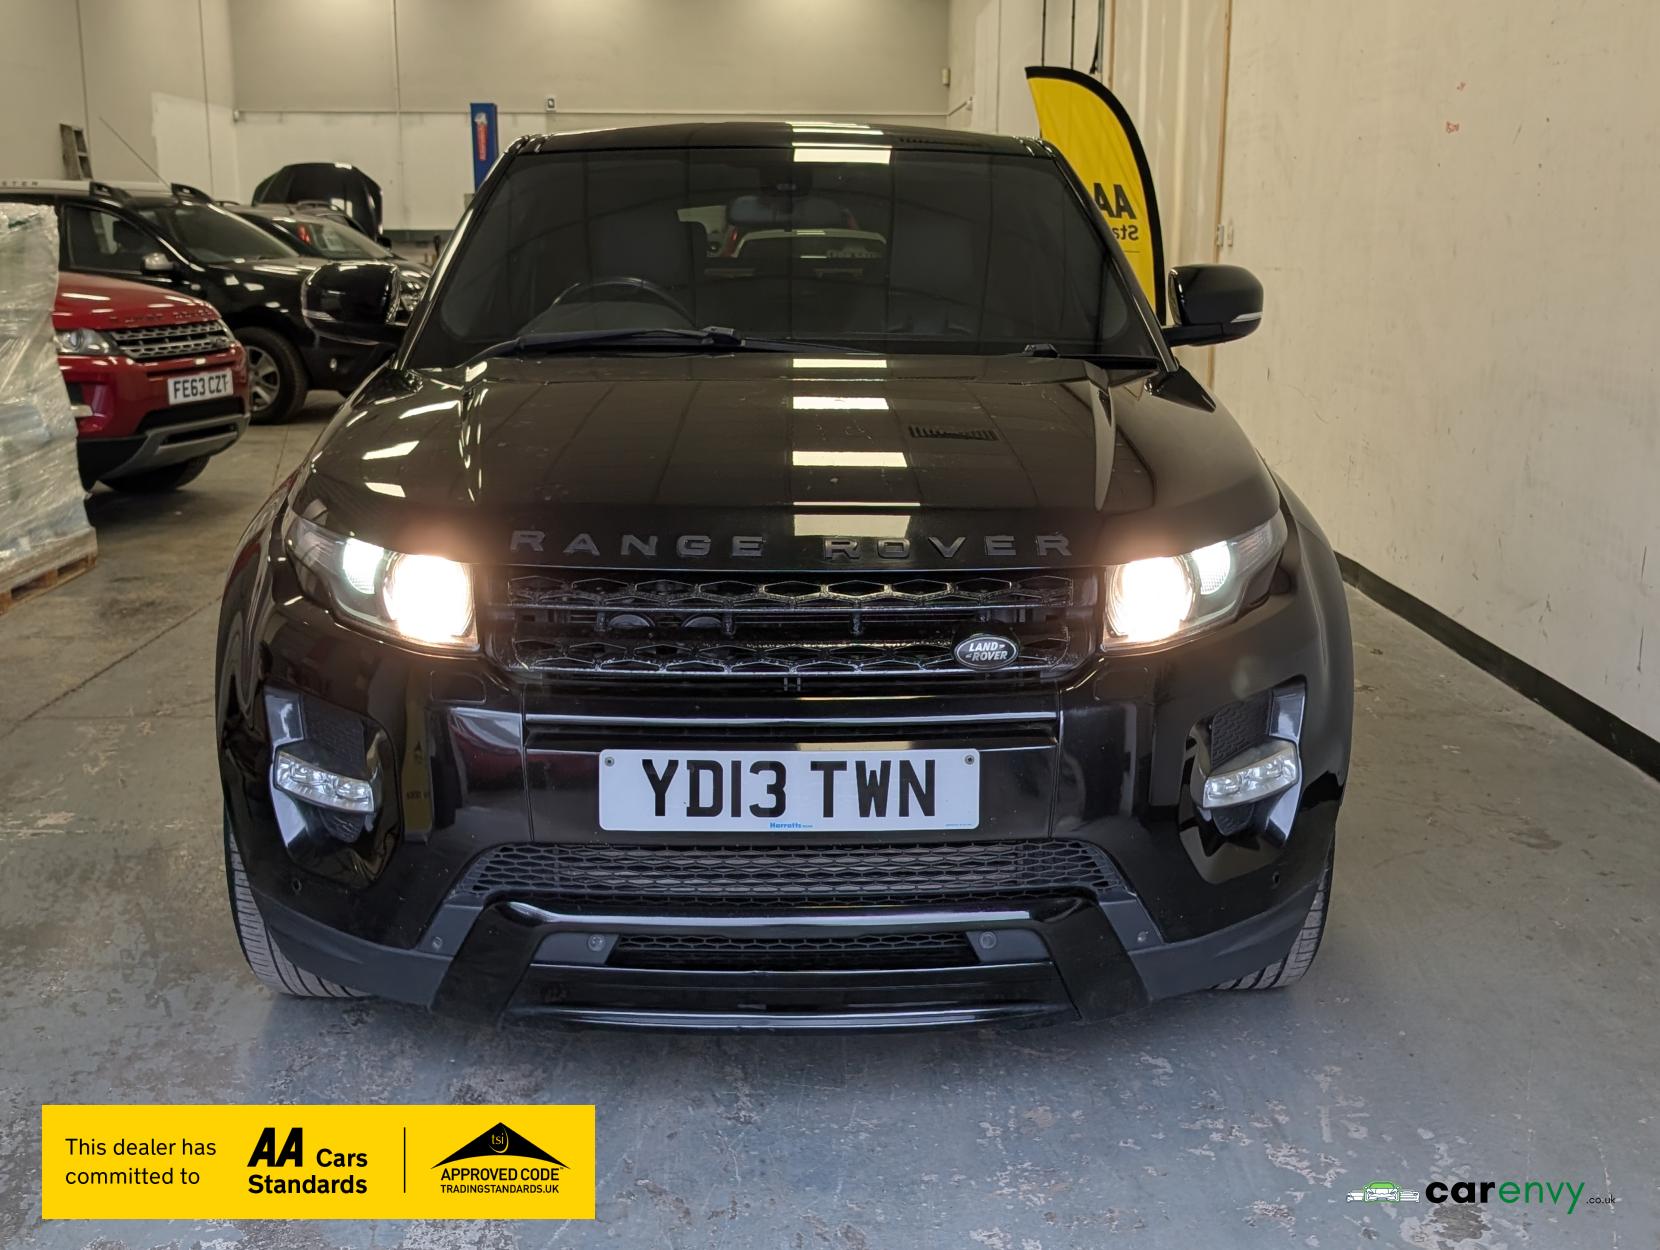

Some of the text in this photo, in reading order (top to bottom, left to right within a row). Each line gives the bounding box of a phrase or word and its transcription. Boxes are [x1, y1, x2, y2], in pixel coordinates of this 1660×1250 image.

[173, 374, 228, 399] FE63 CZT
[510, 530, 1072, 560] RANGE ROVER
[969, 642, 999, 652] LAND
[972, 651, 1008, 661] ROVER
[642, 759, 936, 818] YD13 TWN
